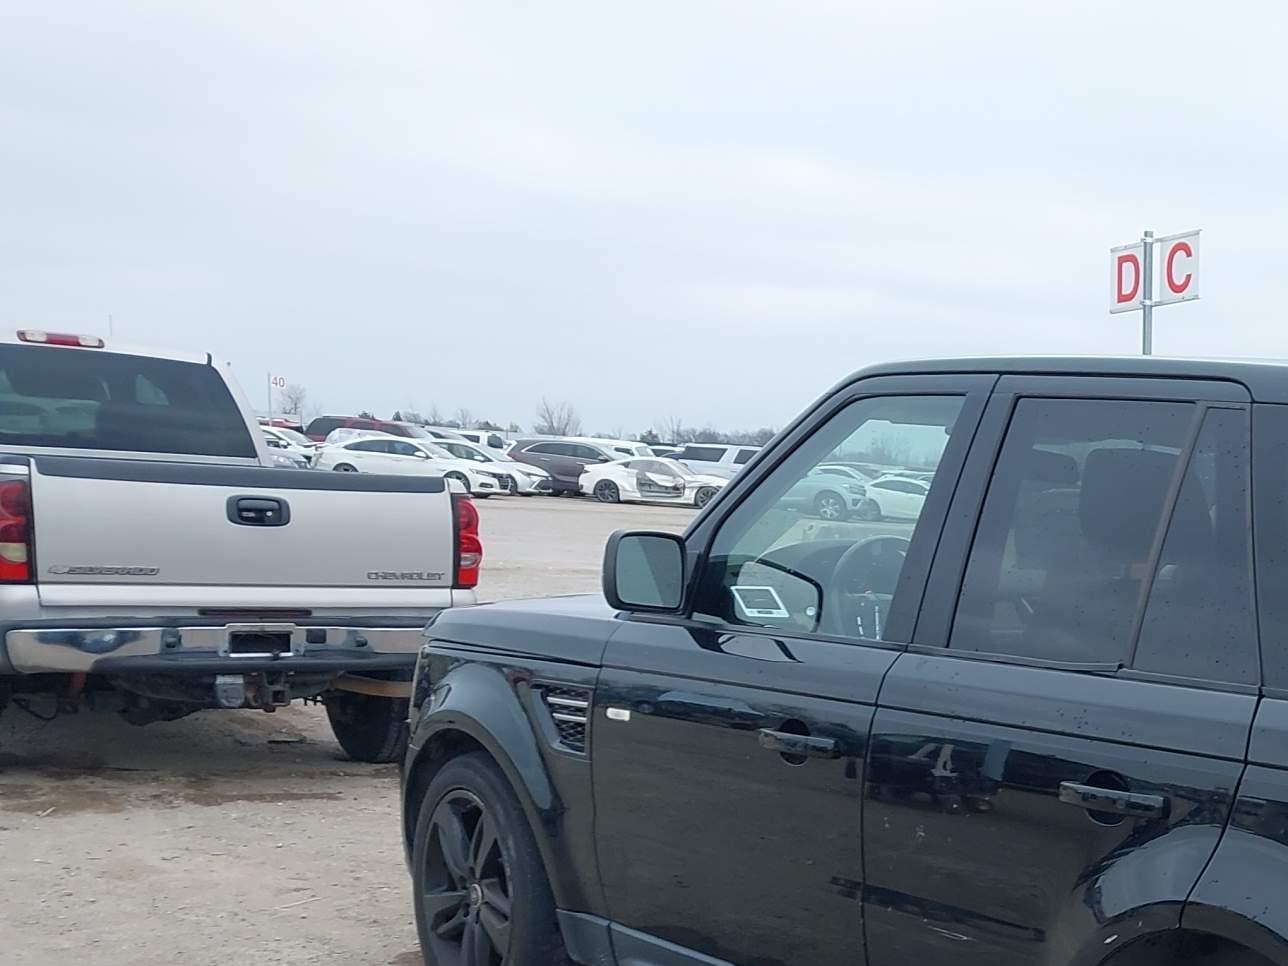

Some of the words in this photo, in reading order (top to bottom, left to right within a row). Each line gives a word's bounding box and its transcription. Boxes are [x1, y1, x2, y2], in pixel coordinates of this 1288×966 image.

[1116, 253, 1141, 304] D
[1166, 241, 1193, 294] C
[271, 375, 285, 388] 40
